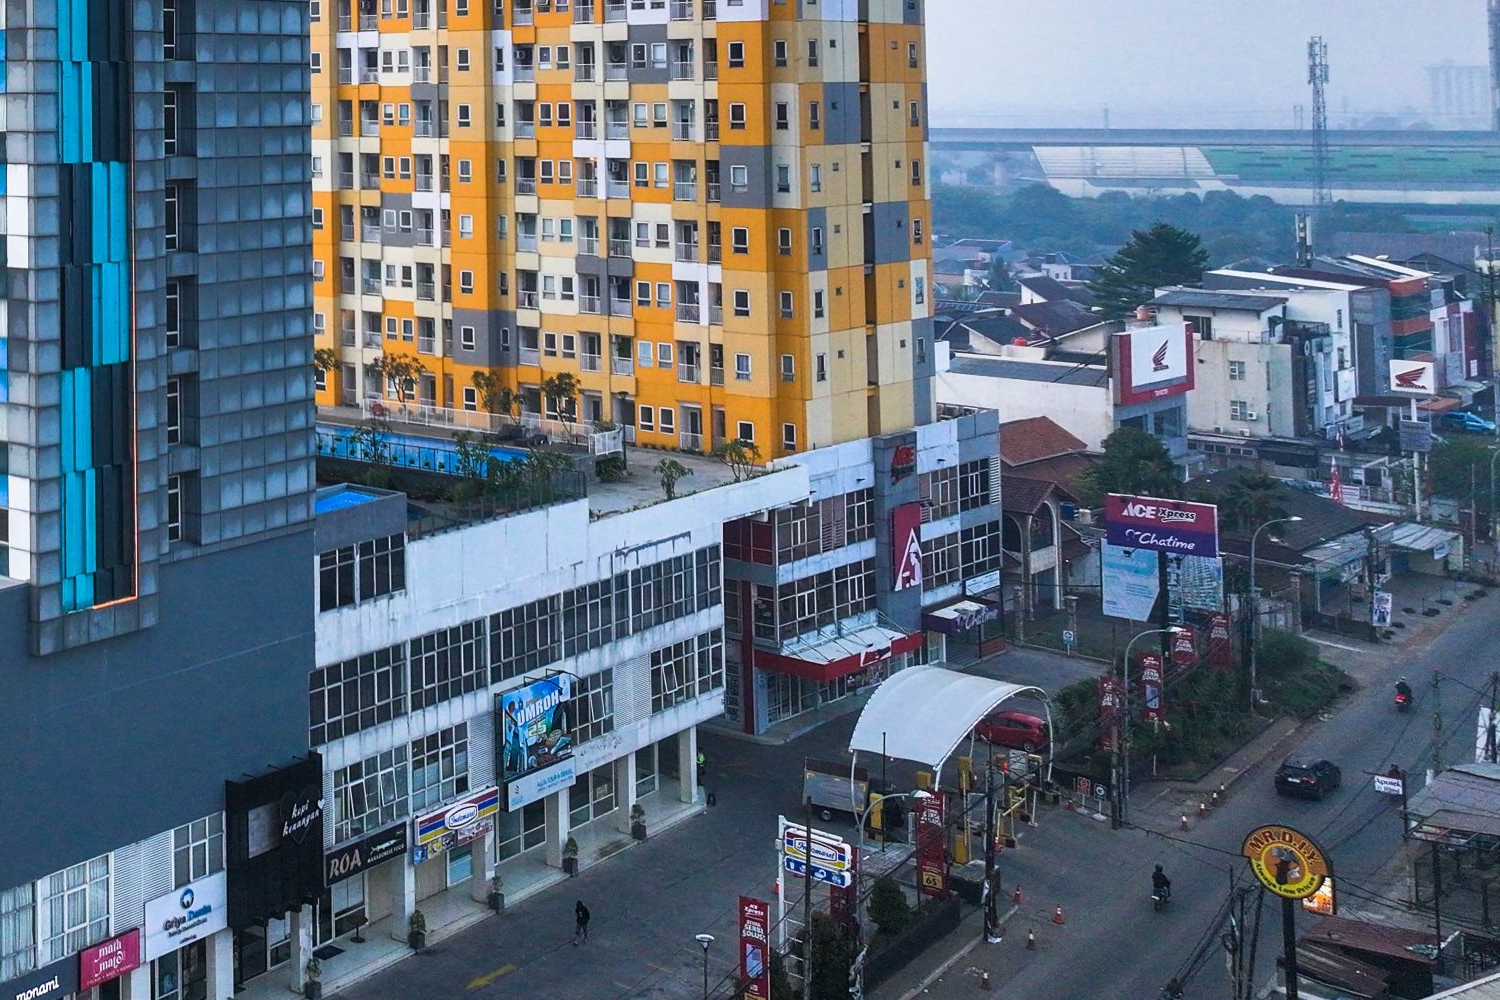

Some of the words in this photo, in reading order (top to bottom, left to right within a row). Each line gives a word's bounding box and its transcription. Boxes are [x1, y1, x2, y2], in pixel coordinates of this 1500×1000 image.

[1122, 501, 1157, 519] ACE
[1158, 507, 1197, 521] Xpress
[1138, 531, 1196, 550] Chatime
[517, 689, 560, 727] UMROH
[528, 721, 547, 738] 25
[291, 799, 310, 819] kopi
[451, 808, 476, 825] Indomaret
[282, 809, 320, 837] kenangan
[796, 841, 835, 859] Inomaret
[1249, 830, 1277, 853] MR
[1280, 830, 1322, 866] D.I.Y.
[329, 848, 362, 879] ROA
[393, 843, 405, 855] FOOD
[925, 876, 937, 886] 65
[1254, 862, 1277, 888] Always
[1279, 885, 1296, 895] Low
[1296, 877, 1316, 894] Prices
[744, 905, 764, 916] Xpress
[15, 976, 60, 1000] monami
